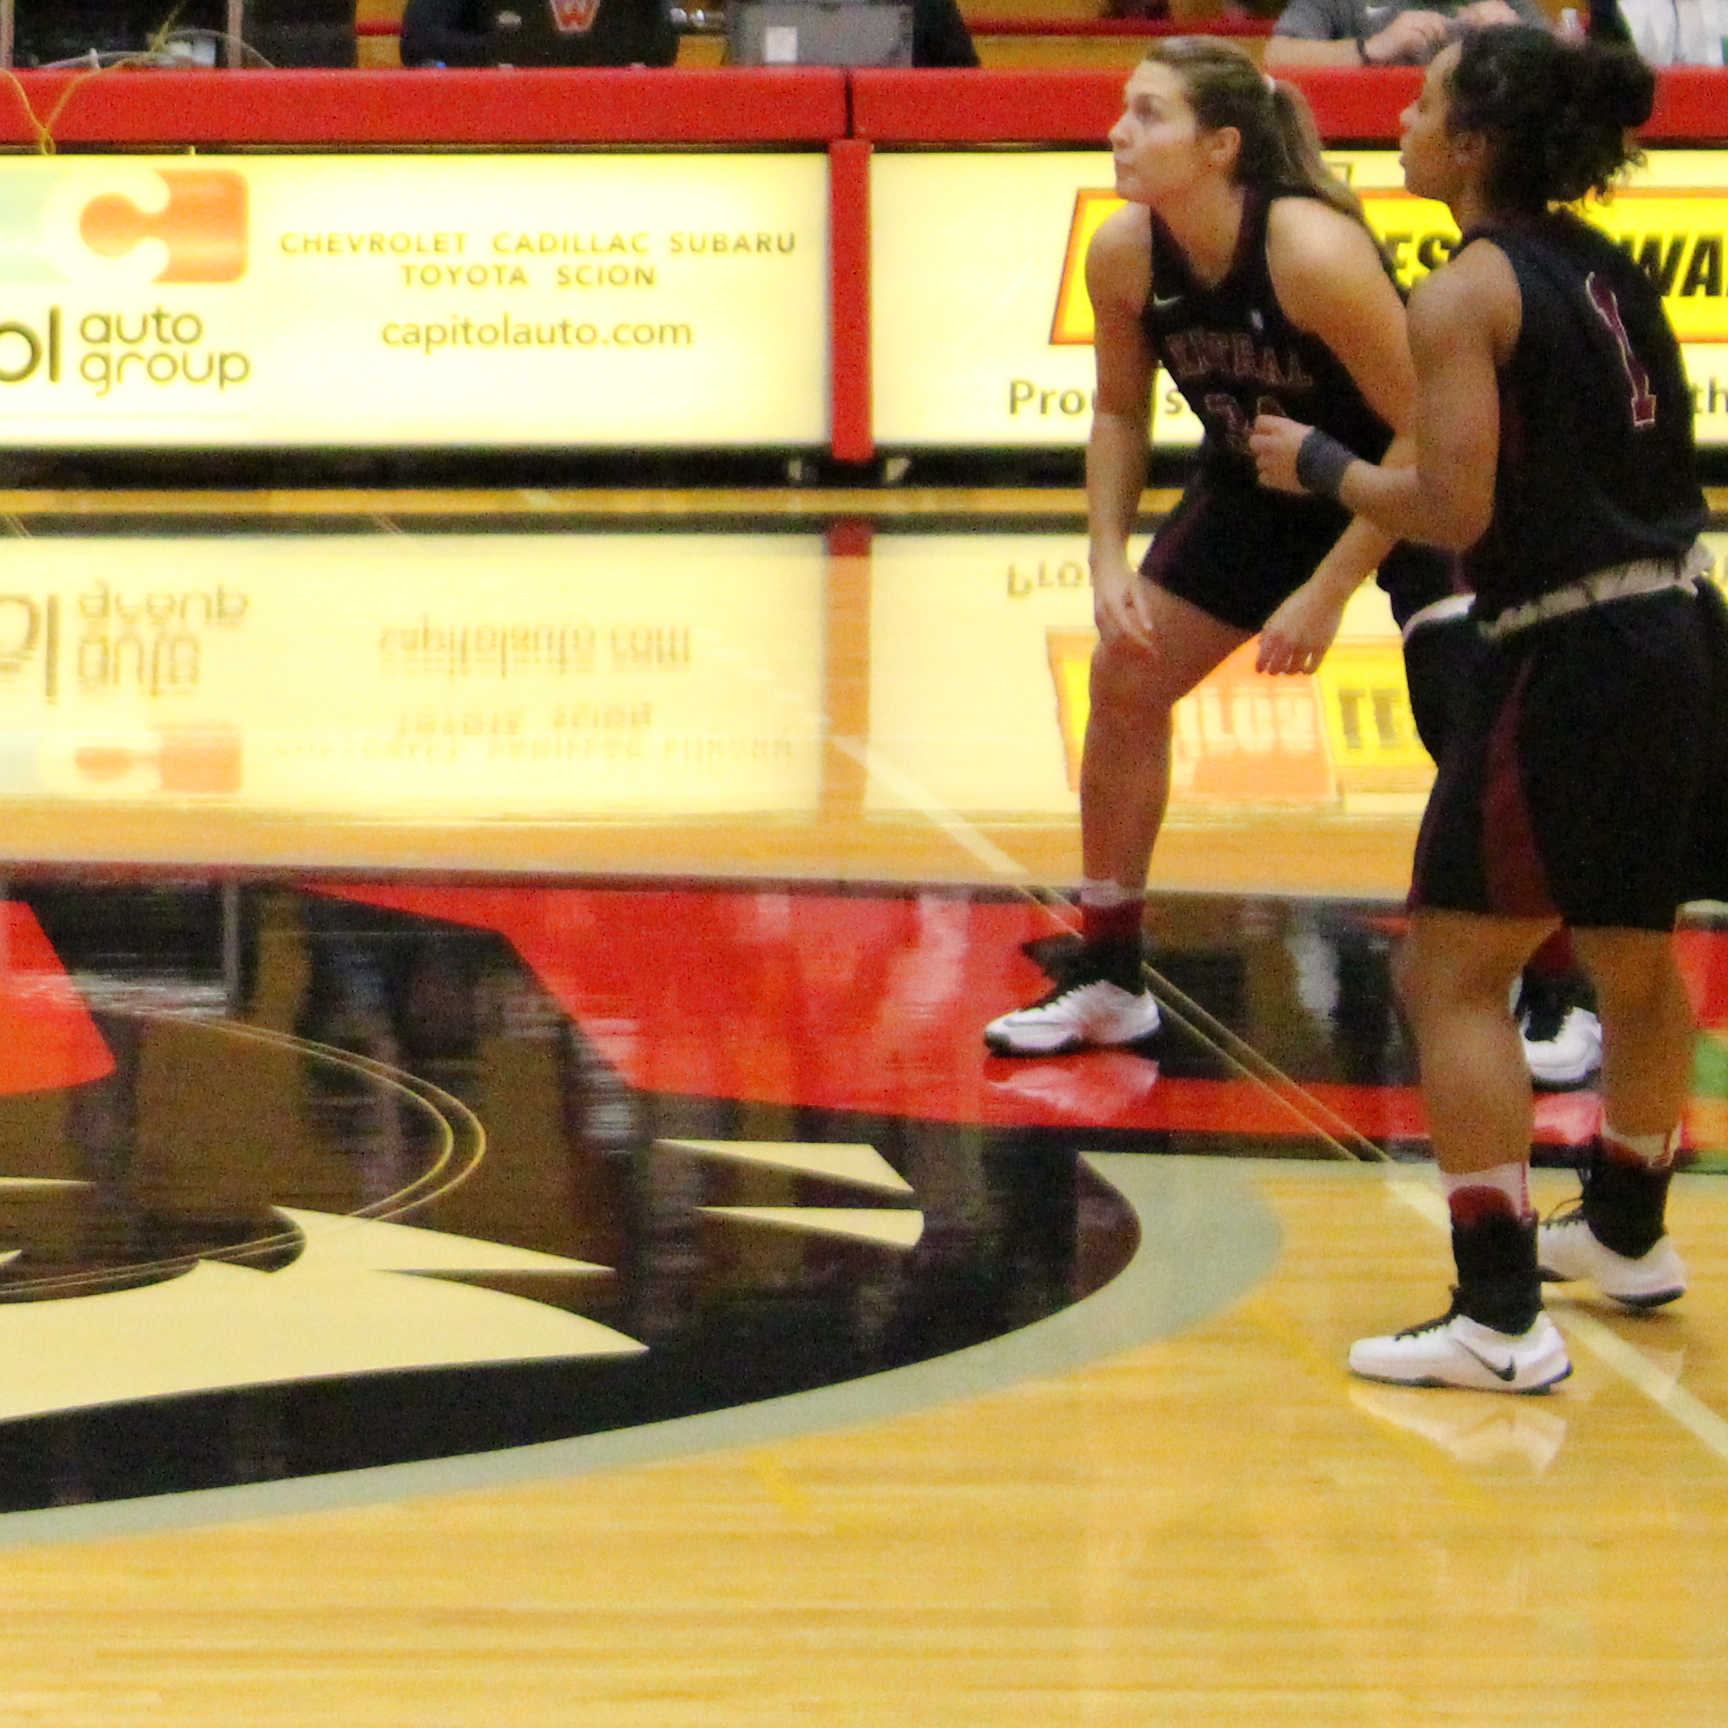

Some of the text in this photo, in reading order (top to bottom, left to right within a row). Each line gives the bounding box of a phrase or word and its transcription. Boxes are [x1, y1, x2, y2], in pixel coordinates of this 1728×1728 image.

[280, 232, 796, 254] CHEVROLET CADILLAC SUBARU
[401, 264, 656, 287] TOYOTA SCION
[80, 306, 204, 345] auto
[381, 313, 694, 353] capitolauto.com
[1585, 272, 1657, 428] 1
[80, 350, 251, 398] group
[1009, 380, 1096, 415] Pro
